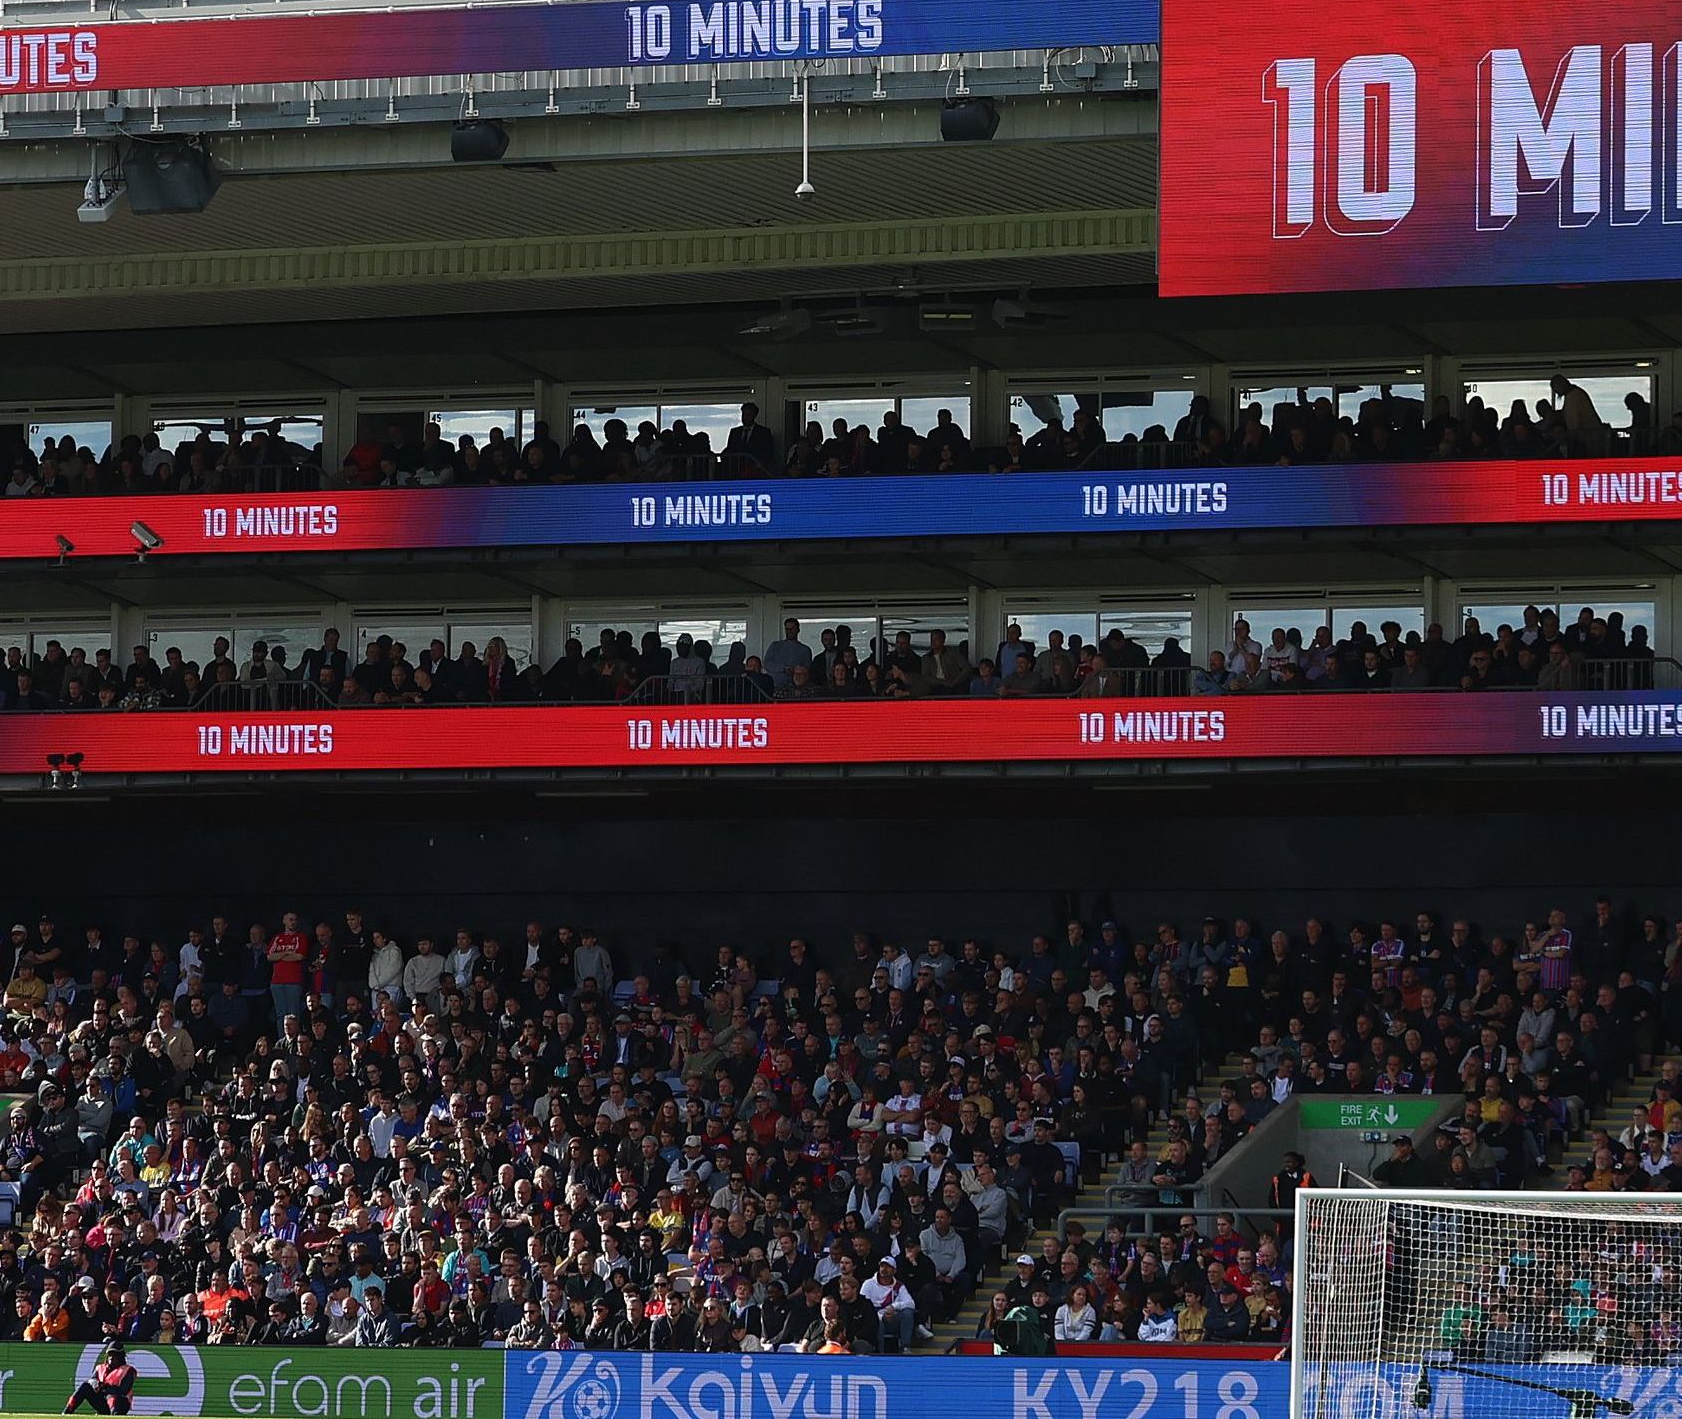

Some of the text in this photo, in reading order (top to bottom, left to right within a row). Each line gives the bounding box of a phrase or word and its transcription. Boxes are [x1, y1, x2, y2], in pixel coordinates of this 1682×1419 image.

[625, 6, 670, 62] 10
[1263, 54, 1416, 238] 10
[807, 403, 818, 412] 43
[29, 425, 40, 434] 47
[1082, 482, 1227, 516] 10 MINUTES
[1542, 474, 1569, 506] 10
[203, 505, 338, 538] 10 MINUTES
[631, 494, 771, 527] 10 MINUTES
[627, 717, 768, 751] 10 MINUTES
[1079, 710, 1225, 744] 10 MINUTES
[1540, 705, 1567, 738] 10
[198, 724, 333, 756] 10 MINUTES
[1340, 1105, 1363, 1114] FIRE
[1340, 1116, 1362, 1126] EXIT
[229, 1358, 392, 1417] efam
[413, 1363, 486, 1418] air
[1012, 1368, 1259, 1419] KY218
